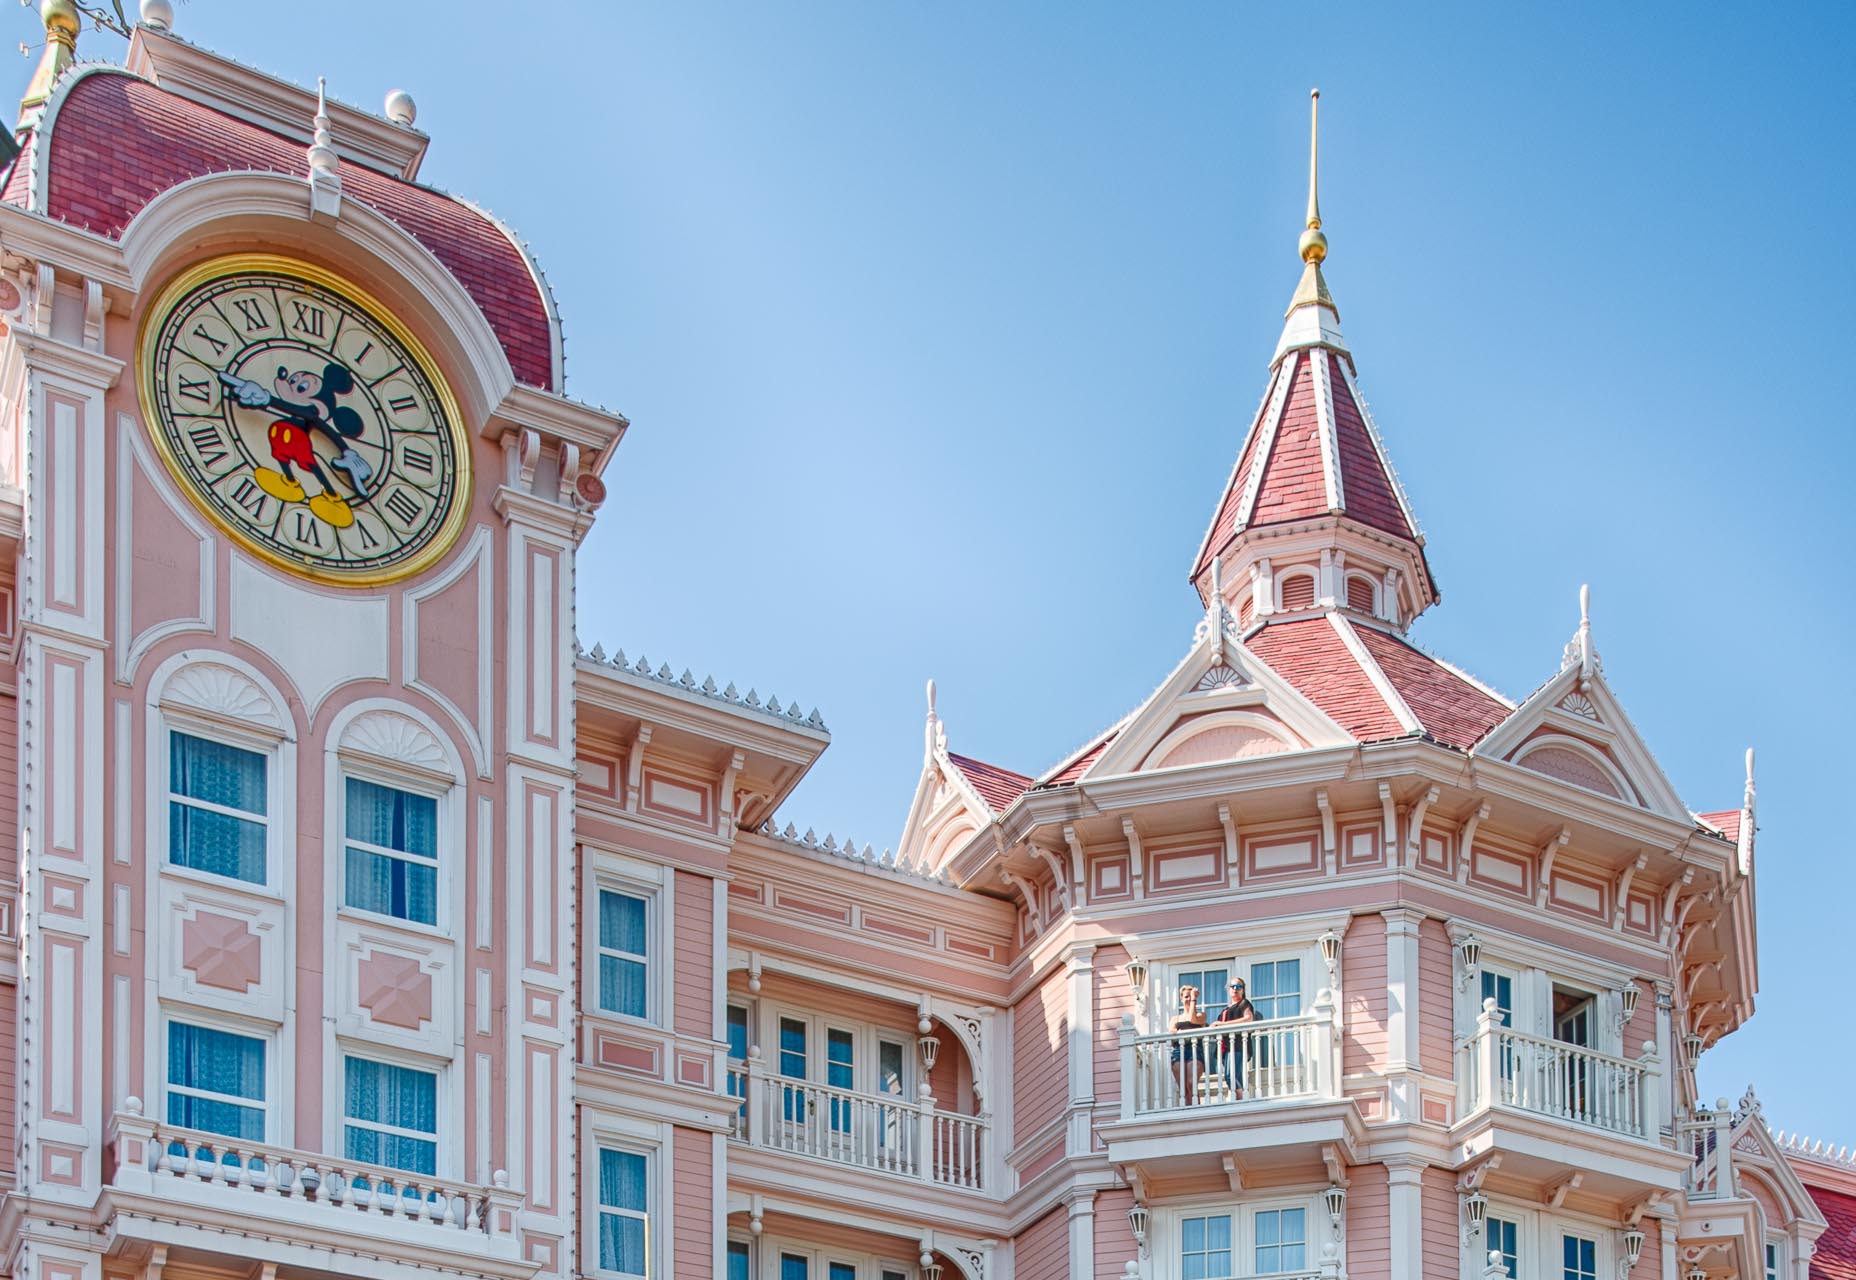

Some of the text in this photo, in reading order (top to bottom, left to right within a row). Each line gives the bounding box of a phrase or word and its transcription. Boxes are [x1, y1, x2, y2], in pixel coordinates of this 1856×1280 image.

[233, 297, 270, 332] XI
[292, 300, 325, 336] XII
[193, 323, 229, 357] X
[353, 341, 374, 364] I
[179, 373, 211, 404] IX
[388, 394, 419, 420] II
[188, 425, 229, 467] VIII
[403, 447, 434, 475] III
[230, 478, 268, 520] VII
[384, 488, 423, 526] IIII
[296, 512, 326, 548] VI
[355, 518, 379, 549] V
